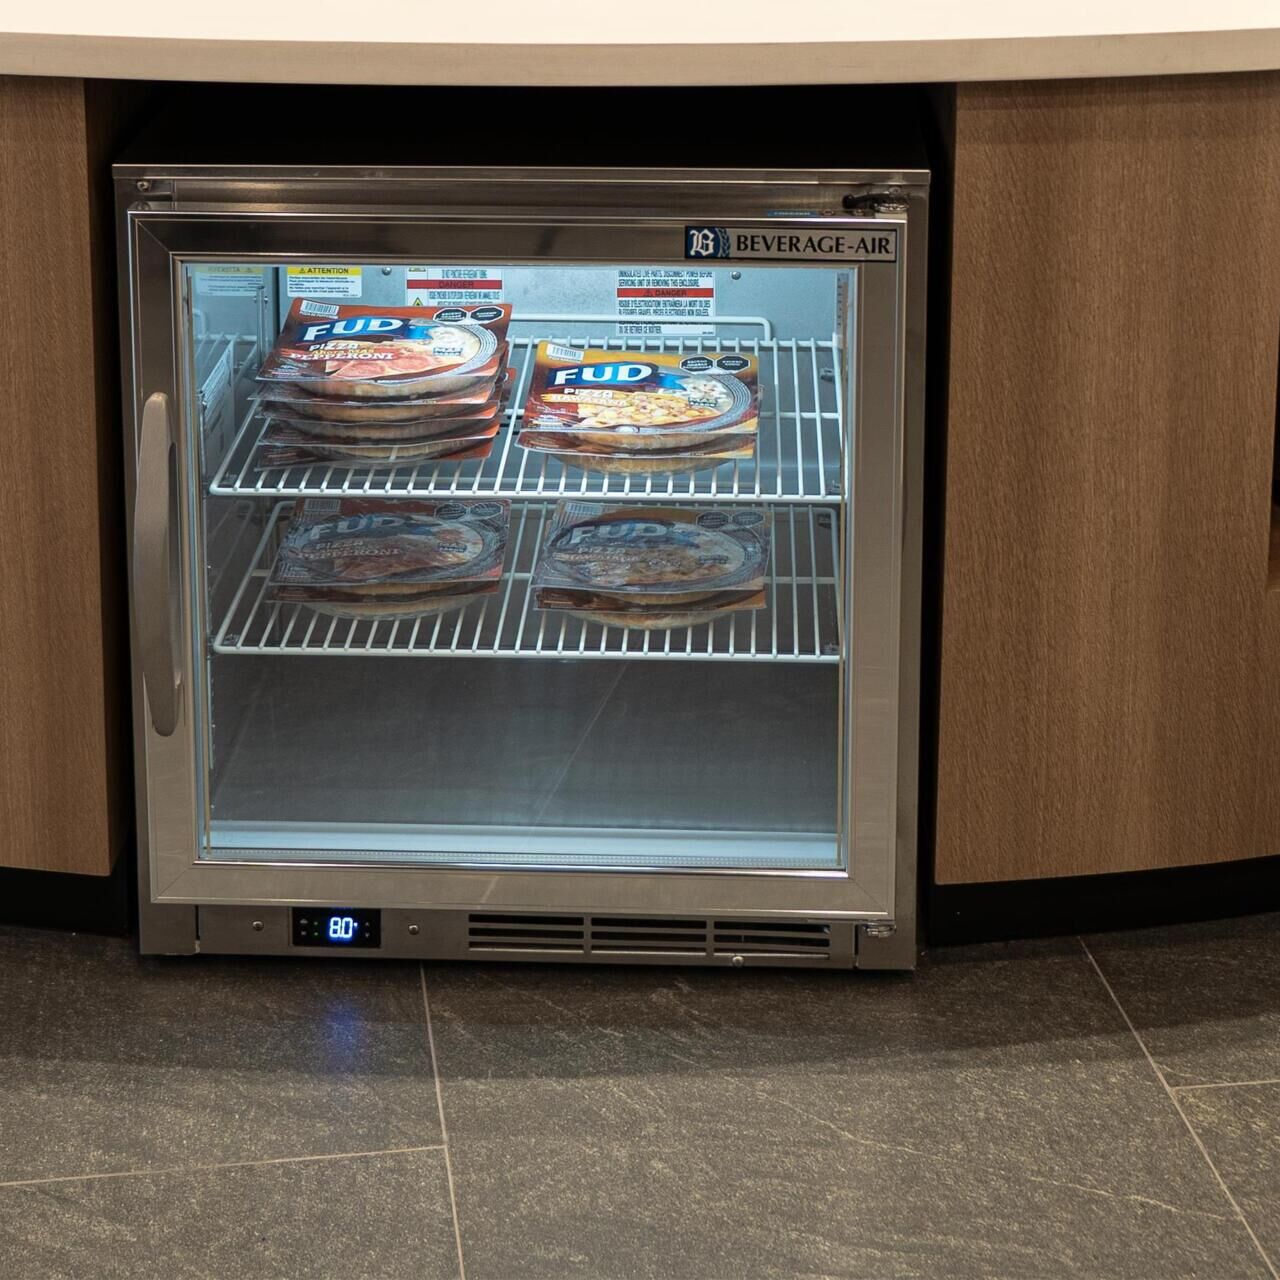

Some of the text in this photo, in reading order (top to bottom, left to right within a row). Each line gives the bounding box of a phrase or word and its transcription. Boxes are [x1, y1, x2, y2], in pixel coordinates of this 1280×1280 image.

[737, 235, 890, 254] BEVERAGE-AIR
[304, 319, 403, 341] FUD
[554, 364, 652, 385] FUD
[311, 515, 406, 539] FUD
[571, 523, 667, 544] FUD
